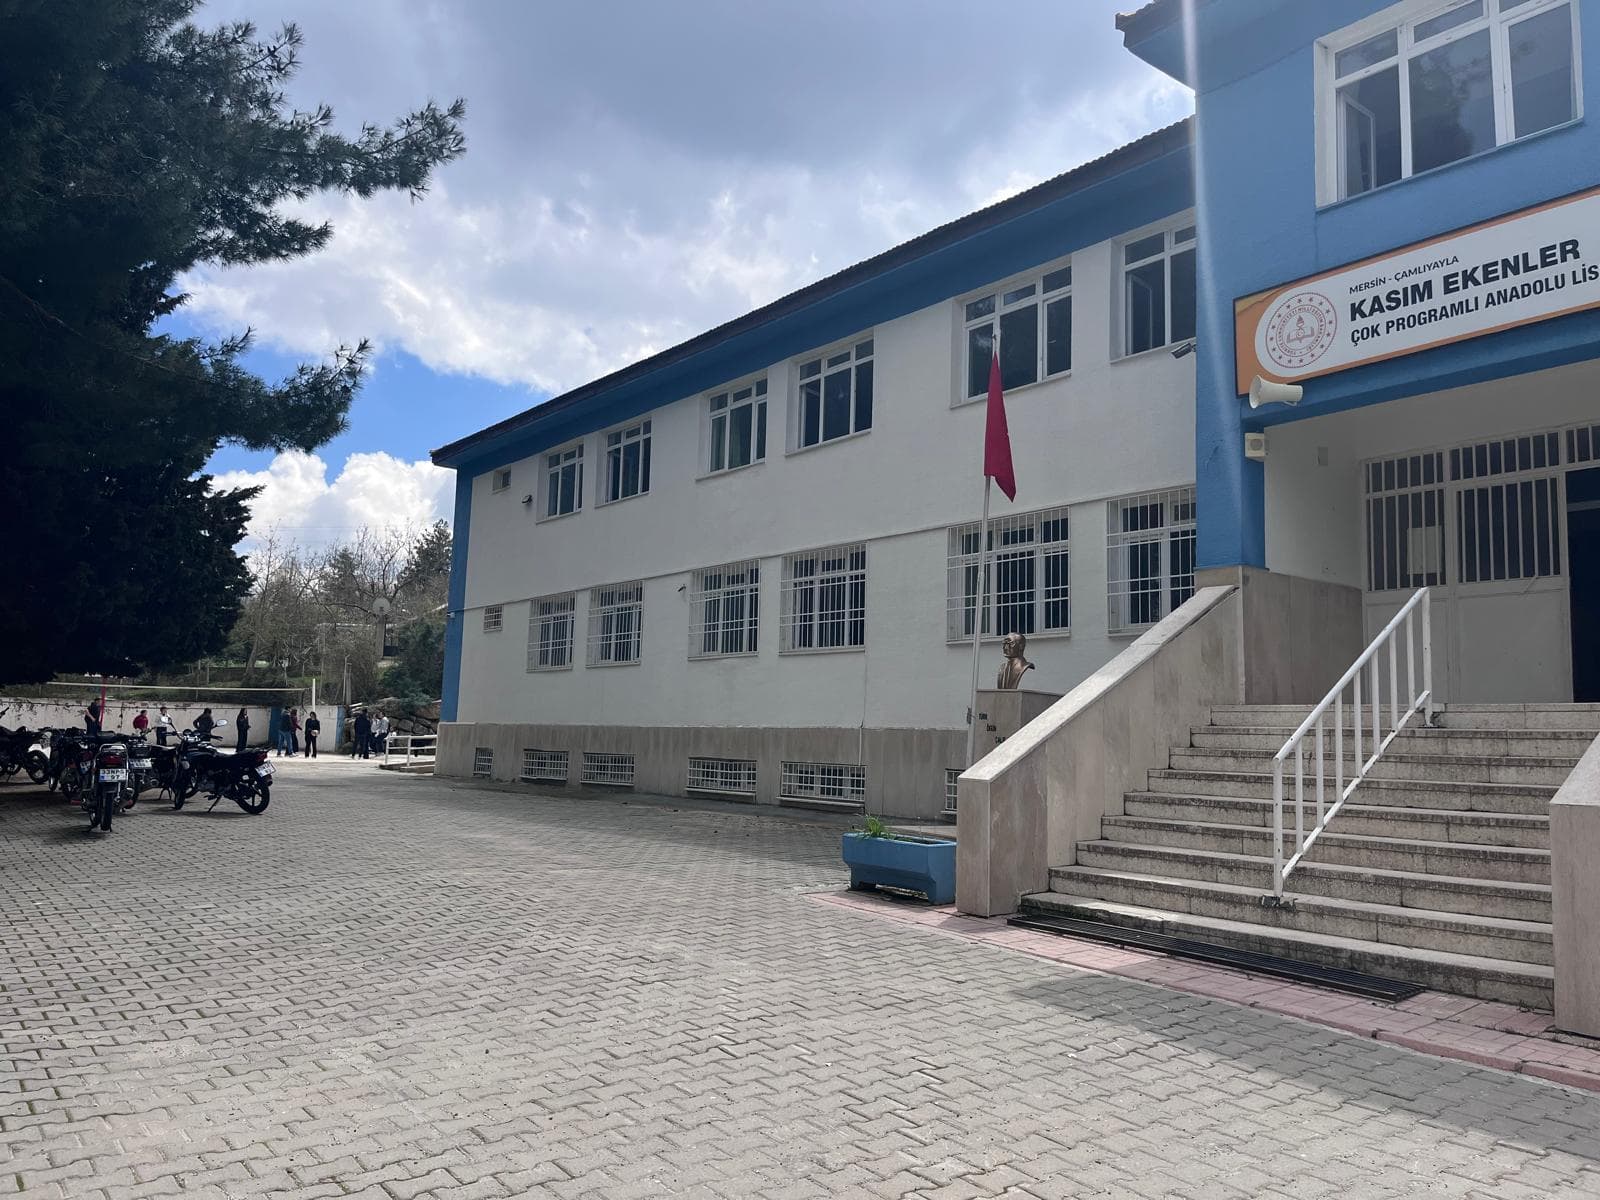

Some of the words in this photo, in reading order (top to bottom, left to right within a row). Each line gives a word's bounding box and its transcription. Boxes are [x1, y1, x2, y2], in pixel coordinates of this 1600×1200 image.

[1349, 276, 1386, 295] MERSİN
[1394, 255, 1459, 282] ÇAMLIYAYLA
[1350, 279, 1433, 322] KASIM
[1443, 238, 1580, 295] EKENLER
[1351, 323, 1381, 347] ÇOK
[1386, 296, 1479, 335] PROGRAMLI
[1485, 273, 1565, 309] ANADOLU
